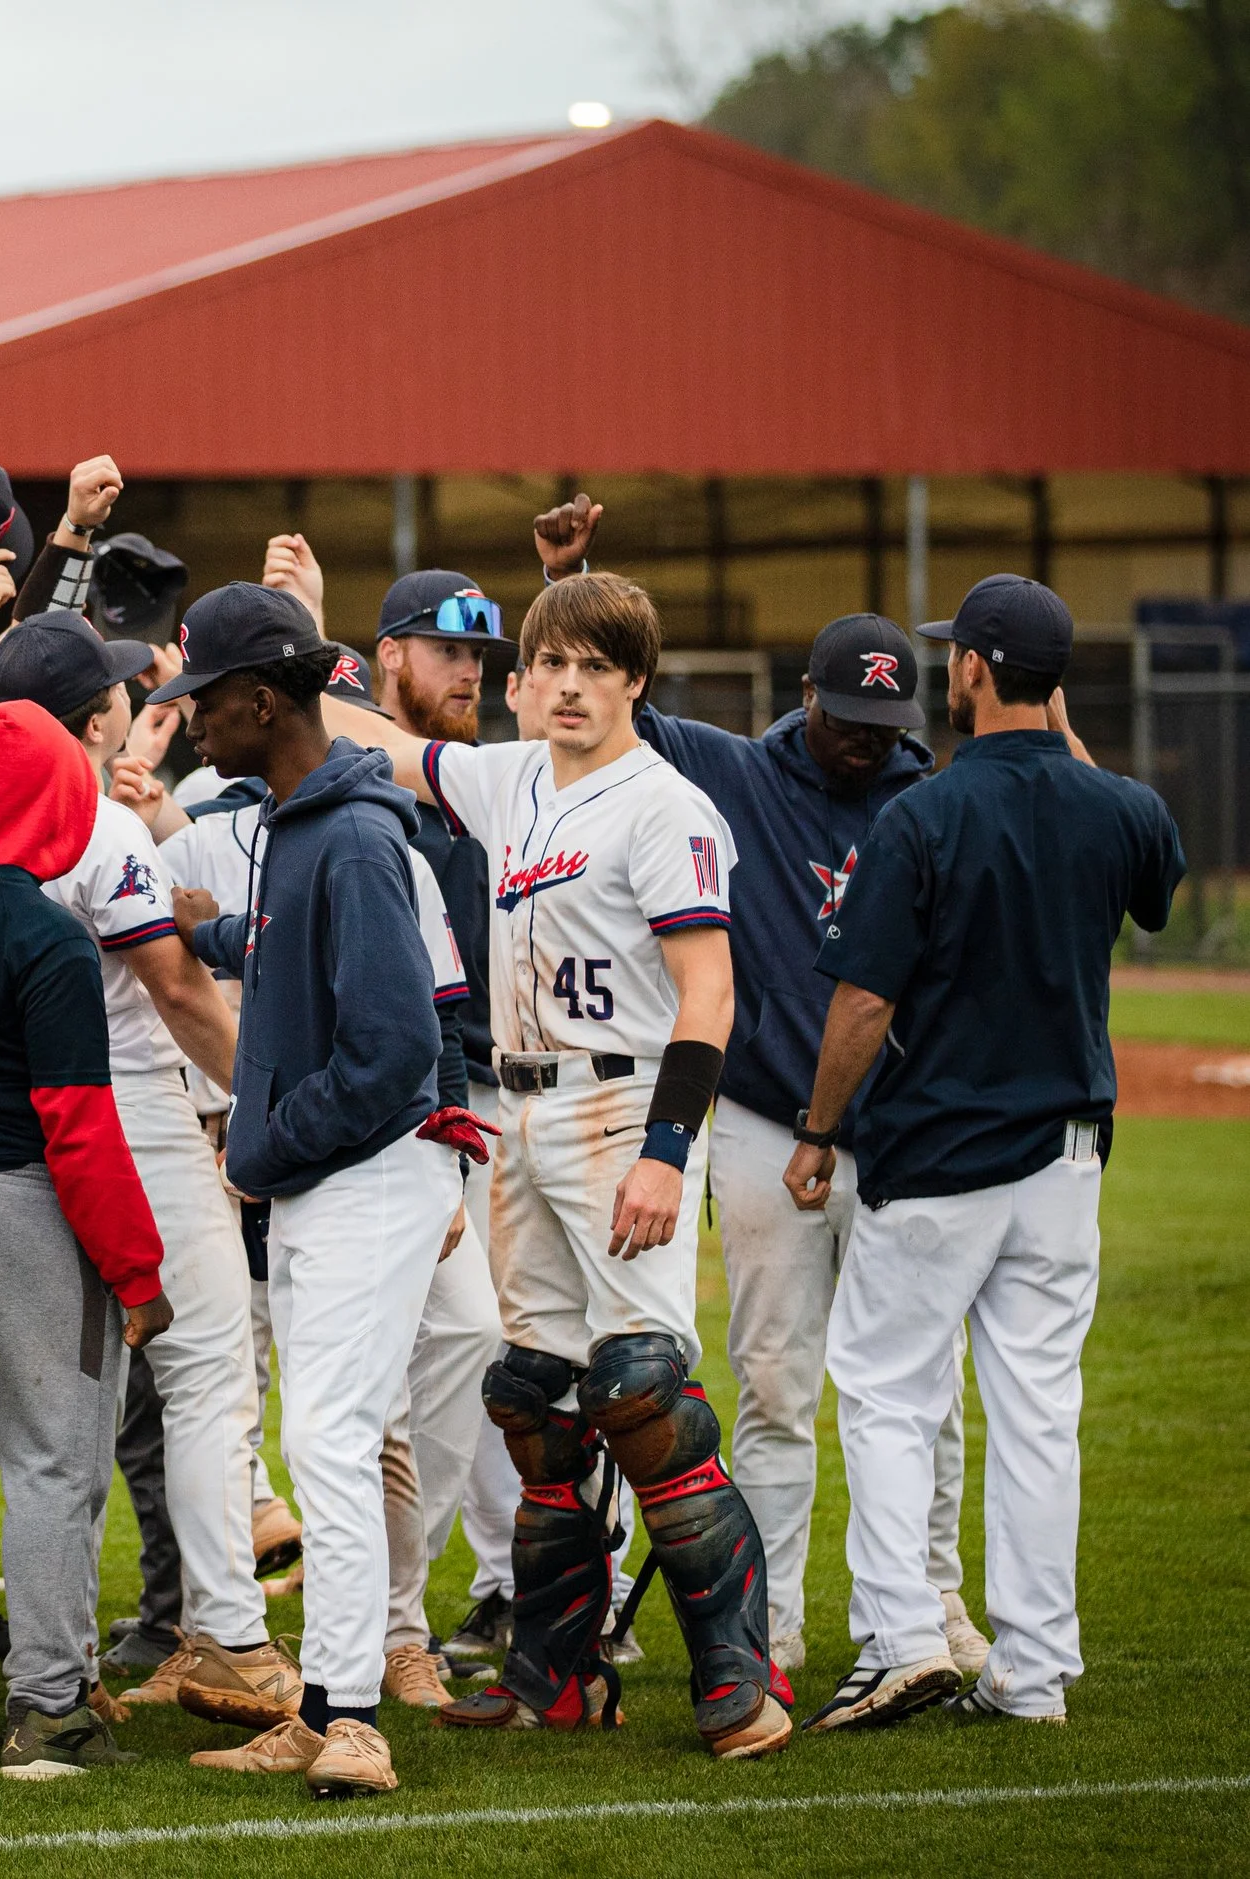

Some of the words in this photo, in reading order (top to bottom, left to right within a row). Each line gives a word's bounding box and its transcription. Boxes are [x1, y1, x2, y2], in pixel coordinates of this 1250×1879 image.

[328, 655, 365, 691] R
[859, 652, 900, 692] R
[553, 957, 614, 1020] 45
